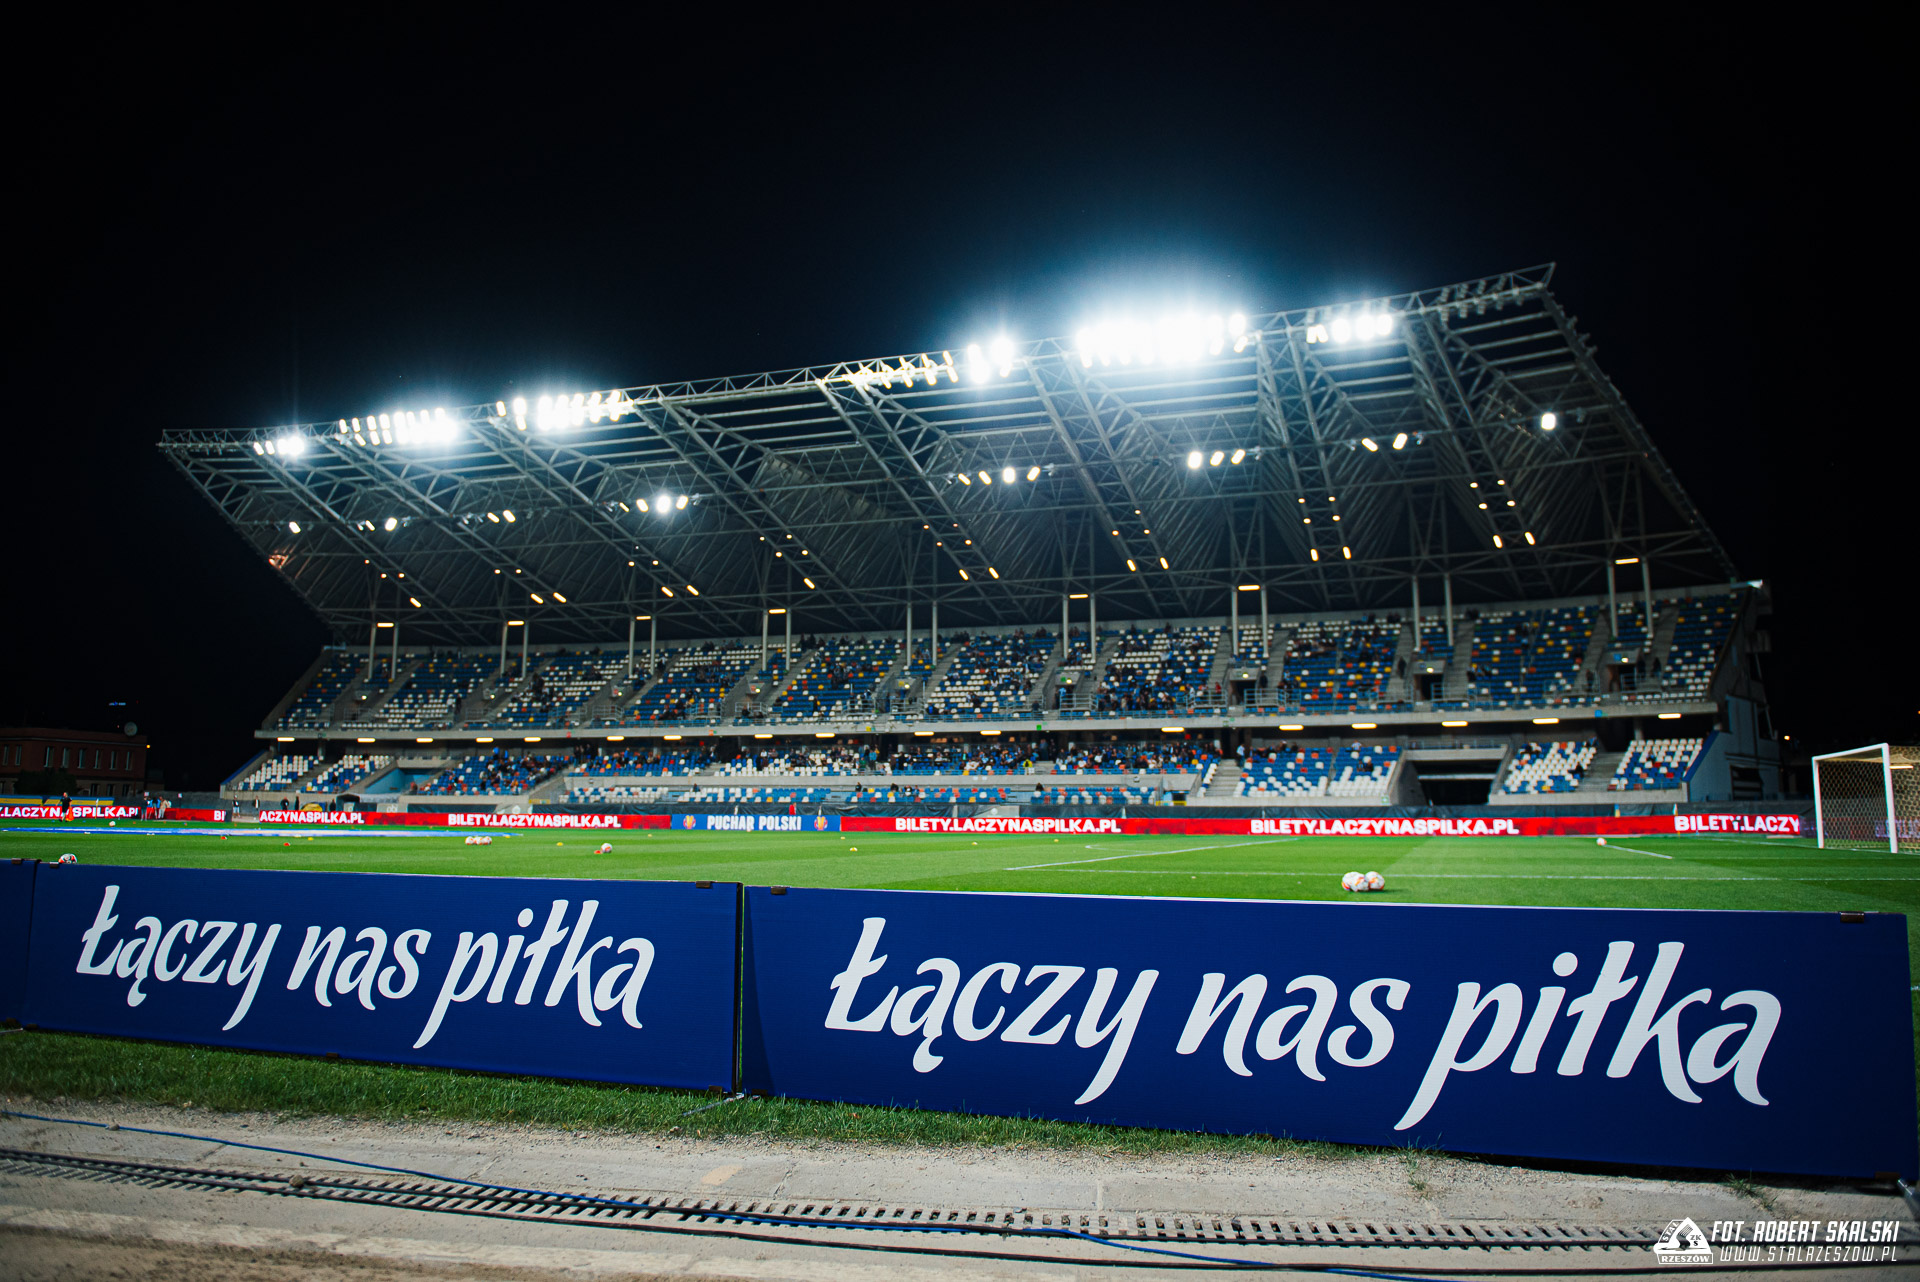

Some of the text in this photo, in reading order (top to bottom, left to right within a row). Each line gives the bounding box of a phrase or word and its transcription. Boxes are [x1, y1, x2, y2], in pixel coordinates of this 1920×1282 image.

[0, 806, 139, 818] .LACZYNSPILKA.P
[448, 813, 622, 828] BILETY.LACZYNASPILKA.PL
[706, 815, 802, 831] PUCHAR POLSKI
[895, 817, 1122, 833] BILETY.LACZYNASPILKA.PL
[1250, 819, 1520, 835] BILETY.LACZYNASPILKA.PL
[1674, 814, 1799, 833] BILETY.LACZY
[76, 885, 655, 1049] Łączy nas piłka
[824, 917, 1782, 1131] Łączy nas piłka
